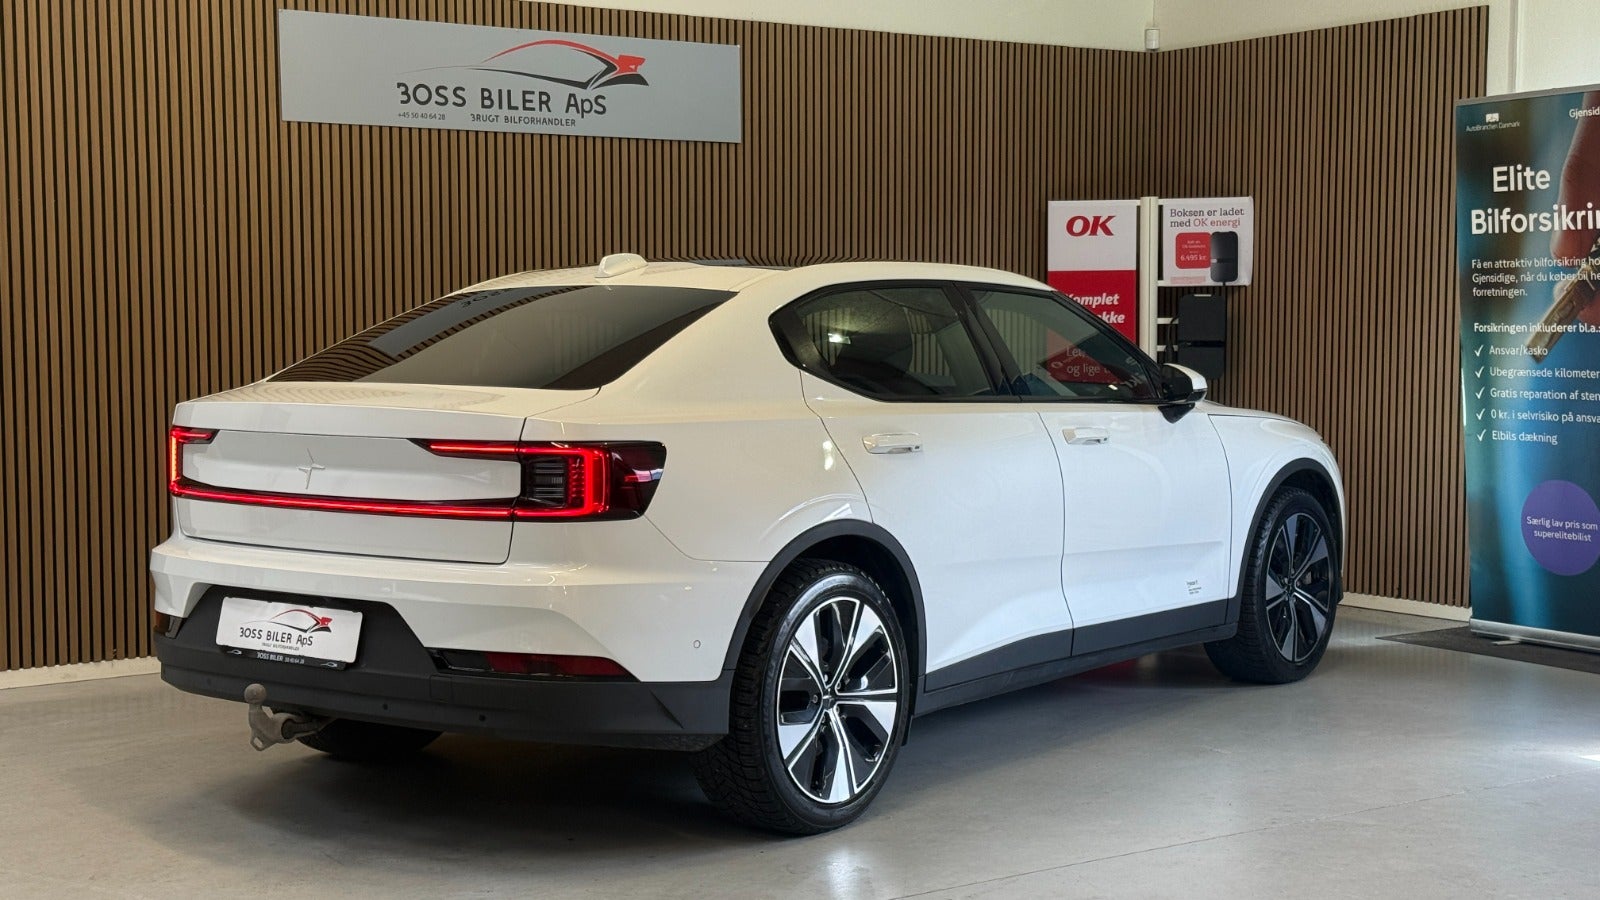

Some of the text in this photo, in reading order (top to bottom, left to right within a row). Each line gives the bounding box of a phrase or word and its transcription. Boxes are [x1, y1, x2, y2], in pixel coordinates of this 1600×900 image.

[397, 82, 607, 119] BOSS BILER ApS
[504, 115, 576, 127] BILFORHANDLER
[1492, 164, 1550, 192] Elite
[1170, 208, 1204, 218] Boksen
[1220, 208, 1244, 216] ladet
[1066, 215, 1116, 236] OK
[1170, 218, 1240, 228] med OK energi
[1472, 260, 1482, 268] Få
[1494, 258, 1532, 268] attraktiv
[1534, 256, 1586, 268] bilforsikring
[1472, 273, 1518, 285] Gjensidige,
[1520, 272, 1534, 281] når
[1536, 272, 1548, 281] du
[1550, 271, 1577, 281] køber
[1472, 287, 1528, 299] forretningen.
[1474, 322, 1528, 334] Forsikringen
[1530, 323, 1577, 333] inkluderer
[1489, 344, 1548, 356] Ansvar/kasko
[1066, 365, 1080, 377] og
[1082, 363, 1100, 376] lige
[1489, 366, 1552, 379] Ubegrænsede
[1490, 388, 1518, 398] Gratis
[1520, 390, 1567, 400] reparation
[1569, 390, 1580, 400] af
[1490, 409, 1497, 419] 0
[1498, 409, 1510, 419] kr.
[1517, 410, 1560, 422] selvrisiko
[1562, 412, 1574, 424] på
[1492, 430, 1558, 446] Elbils dækning
[1526, 516, 1598, 530] Særlig lav pris som
[1534, 530, 1592, 542] superelitebilist
[266, 630, 292, 644] BILER
[296, 634, 314, 648] ApS
